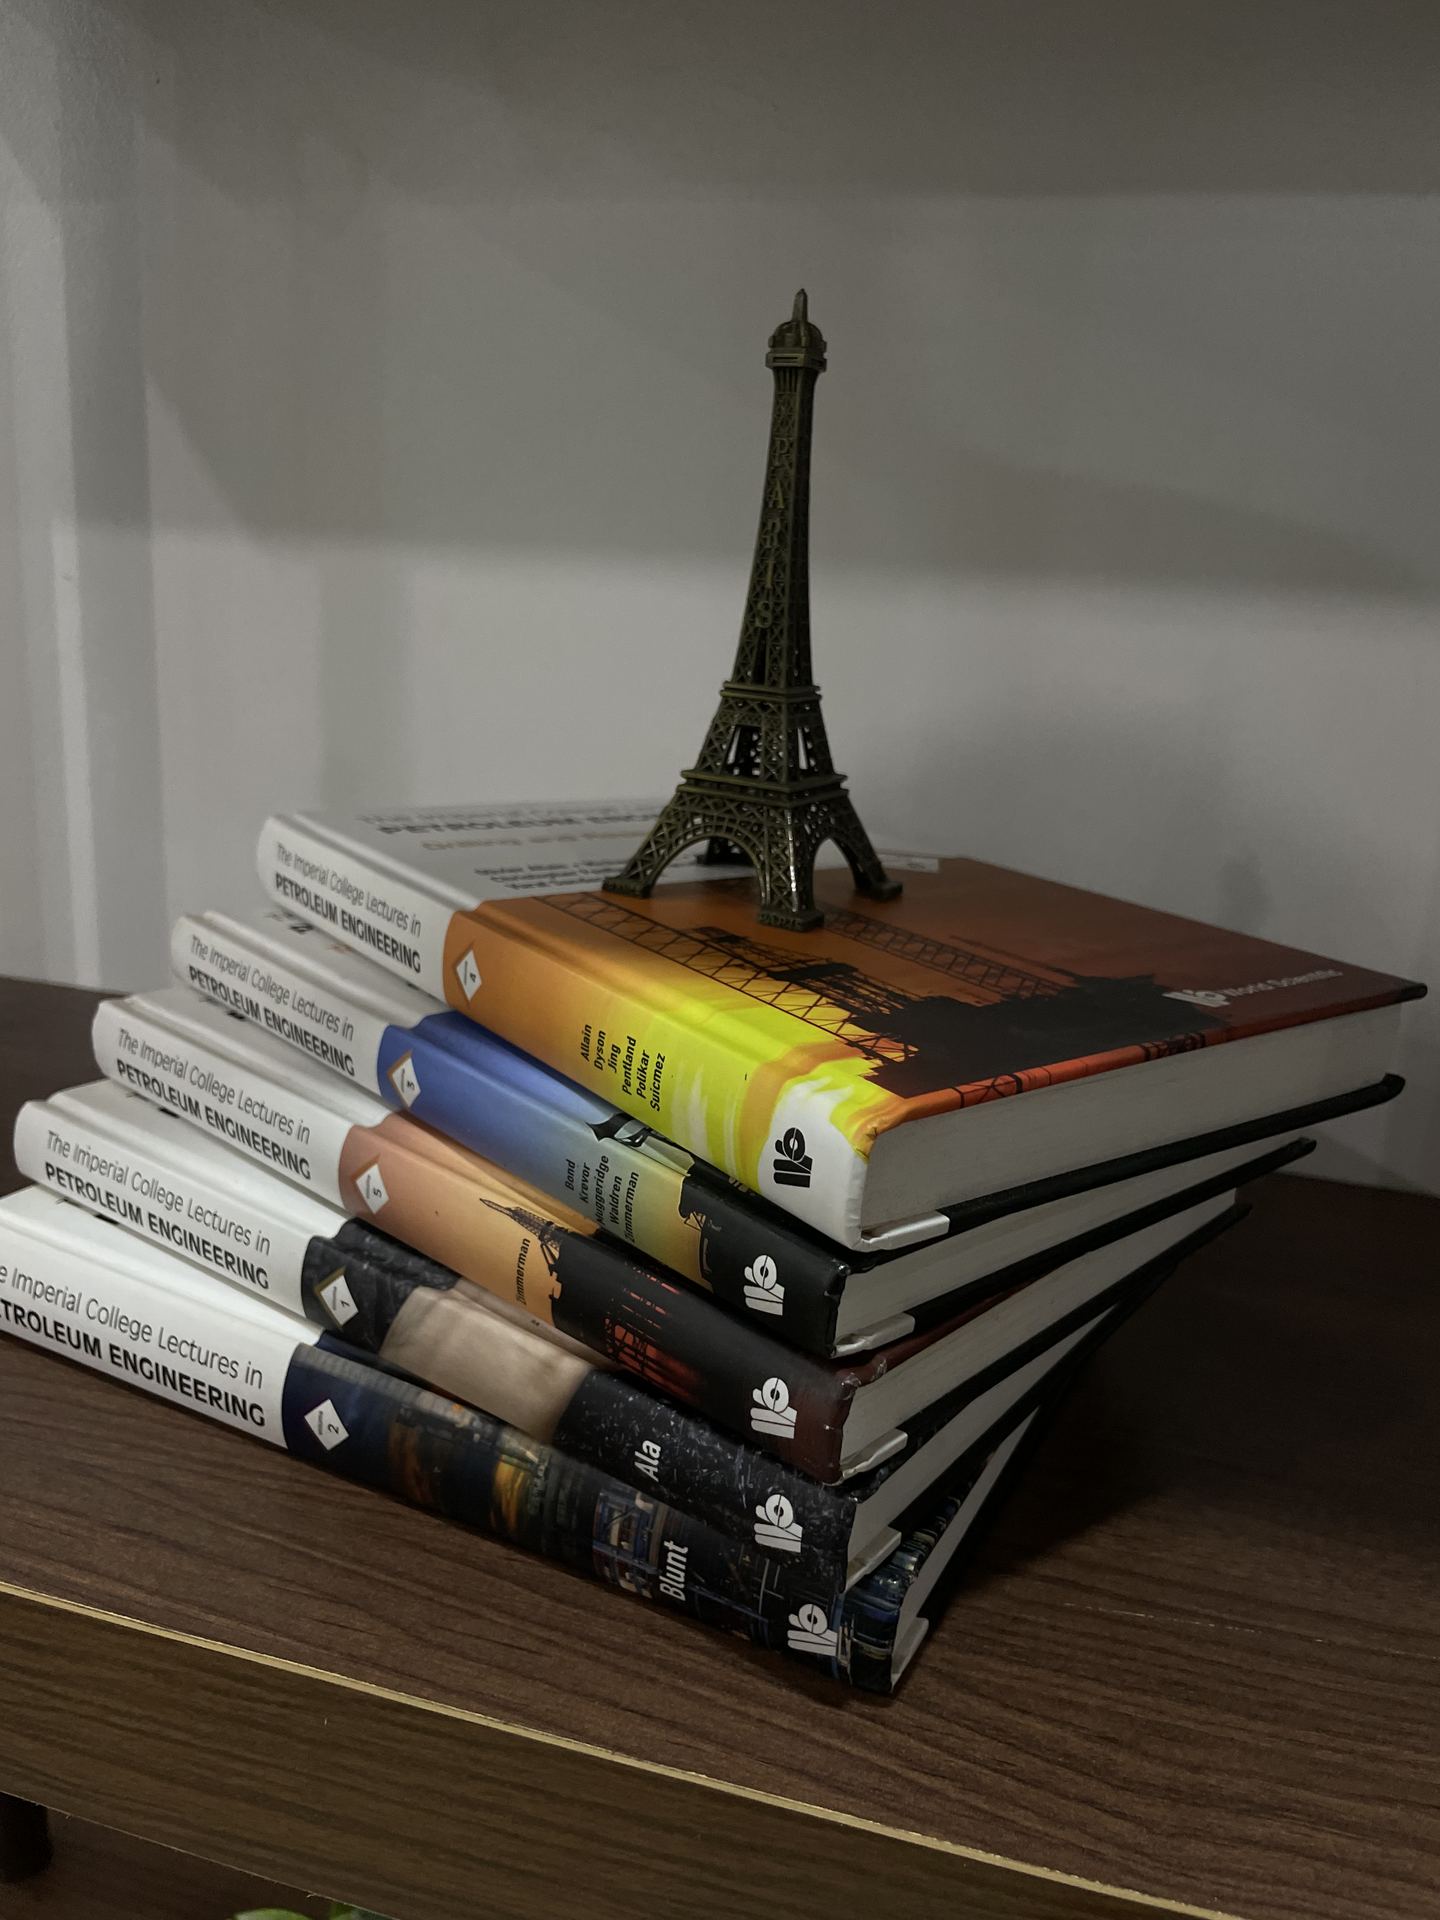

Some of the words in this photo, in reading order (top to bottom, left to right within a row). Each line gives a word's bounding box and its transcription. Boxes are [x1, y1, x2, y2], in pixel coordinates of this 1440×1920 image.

[276, 842, 294, 867] The
[294, 847, 329, 886] Imperial
[330, 864, 364, 906] College
[366, 885, 408, 931] Lectures
[411, 913, 422, 937] in
[275, 873, 338, 927] PETROLEUM
[341, 910, 422, 974] ENGINEERING
[191, 935, 208, 961] The
[210, 943, 249, 980] Imperial
[251, 968, 291, 1005] College
[292, 990, 340, 1033] Lectures
[342, 1017, 354, 1041] in
[189, 965, 261, 1021] PETROLEUM
[264, 1008, 355, 1076] ENGINEERING
[580, 1024, 592, 1062] Allain
[594, 1030, 606, 1071] Dyson
[119, 1028, 138, 1056] The
[141, 1039, 186, 1078] Imperial
[190, 1065, 235, 1104] College
[238, 1089, 293, 1136] Lectures
[297, 1120, 310, 1145] in
[607, 1043, 621, 1073] Jing
[622, 1035, 637, 1096] Pentland
[636, 1050, 651, 1100] Polikar
[650, 1052, 666, 1112] Suicmez
[117, 1058, 201, 1120] PETROLEUM
[205, 1106, 311, 1181] ENGINEERING
[48, 1130, 70, 1159] The
[73, 1141, 128, 1184] Imperial
[131, 1172, 183, 1213] College
[187, 1198, 250, 1247] Lectures
[255, 1230, 270, 1255] in
[373, 1187, 382, 1198] 5
[565, 1158, 576, 1191] Bond
[579, 1162, 591, 1204] Krevor
[609, 1175, 622, 1225] Waldren
[45, 1161, 143, 1227] PETROLEUM
[148, 1213, 269, 1290] ENGINEERING
[624, 1171, 639, 1244] Zimmerman
[515, 1237, 531, 1305] Zimmerman
[11, 1267, 82, 1314] Imperial
[86, 1298, 152, 1343] College
[158, 1326, 239, 1379] Lectures
[245, 1361, 263, 1389] in
[341, 1299, 350, 1308] 1
[0, 1299, 102, 1359] TROLEUM
[108, 1343, 266, 1427] ENGINEERING
[327, 1423, 340, 1435] 2
[634, 1439, 662, 1483] Ala
[659, 1540, 689, 1602] Blunt
